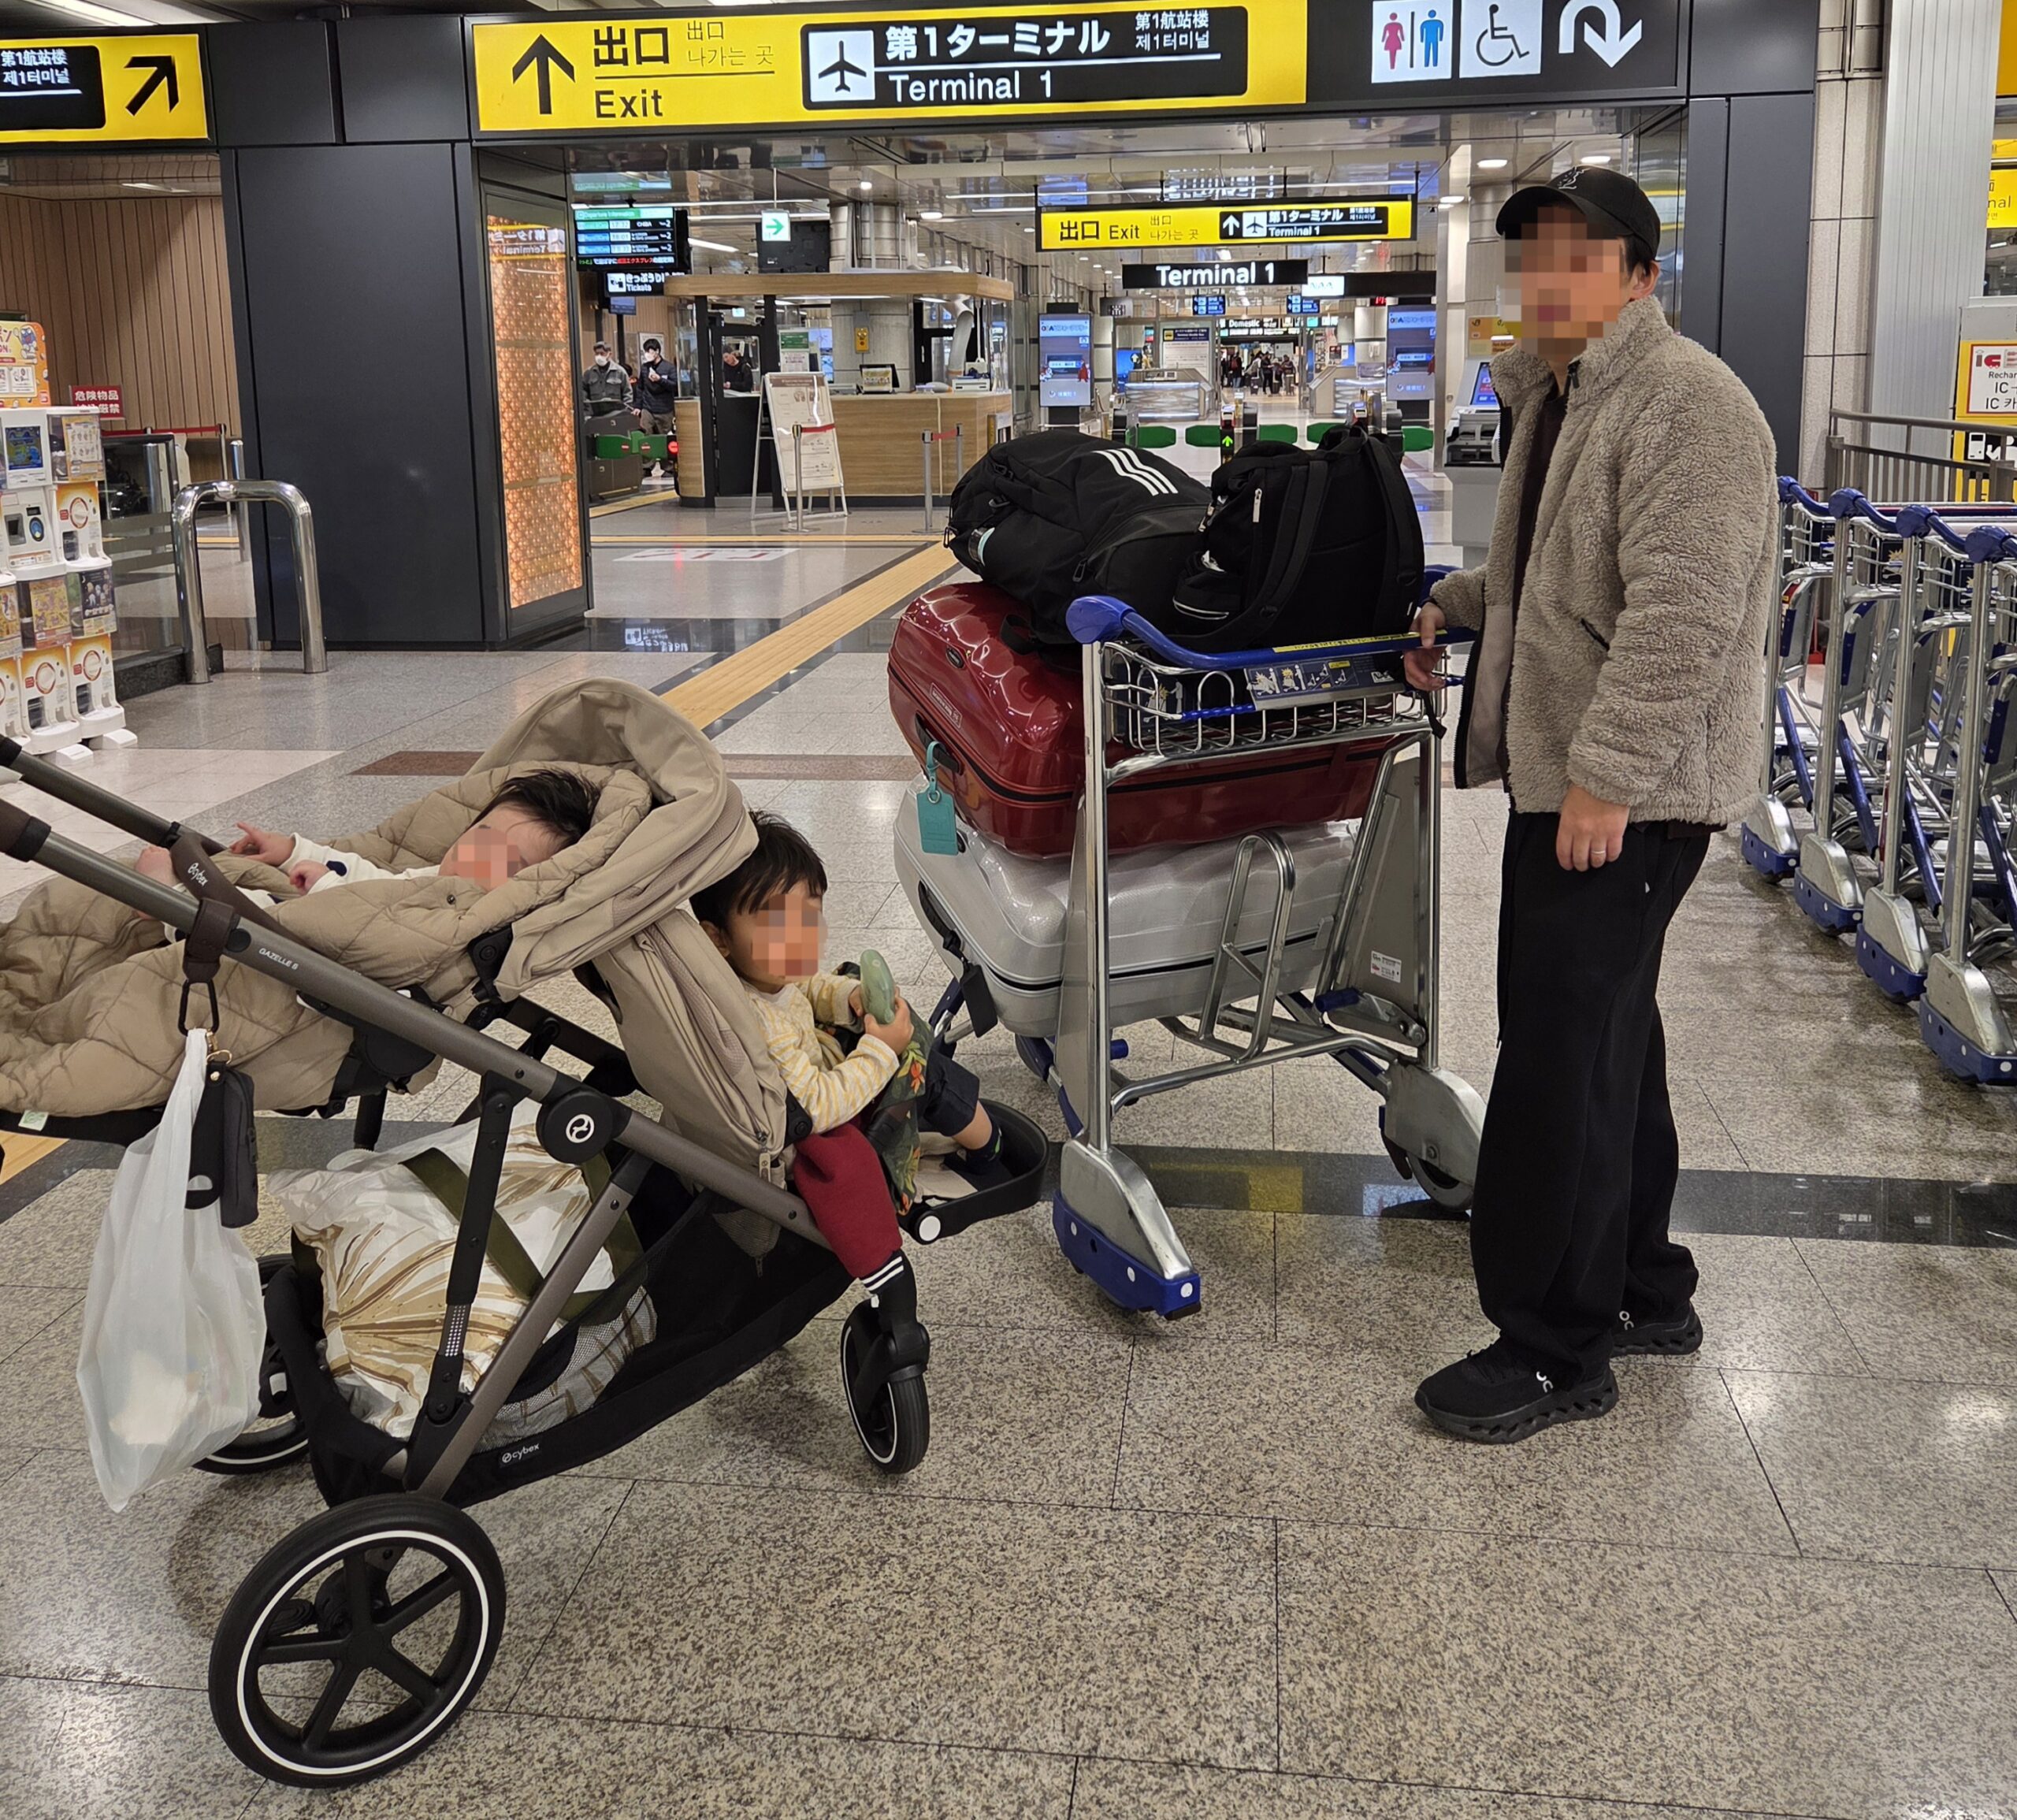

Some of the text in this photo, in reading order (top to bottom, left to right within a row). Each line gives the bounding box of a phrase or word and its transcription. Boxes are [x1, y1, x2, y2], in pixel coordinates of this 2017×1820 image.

[1135, 9, 1209, 31] 第1航站楼
[687, 20, 724, 41] 出口
[593, 25, 670, 67] 出口
[885, 20, 1110, 61] 第1ターミナル
[1135, 31, 1210, 51] 제1터미널
[1, 49, 69, 67] 第1航站楼
[688, 45, 774, 68] 나가는 곳
[3, 68, 70, 86] 제1터미널
[889, 70, 1052, 102] Terminal 1
[596, 88, 663, 119] Exit
[1150, 215, 1172, 226] 出口
[1269, 209, 1344, 223] 第1ターミナル
[1060, 221, 1100, 241] 出口
[1109, 225, 1140, 240] Exit
[1150, 228, 1199, 241] 나가는 곳
[1269, 225, 1321, 236] Terminal 1
[1155, 262, 1275, 287] Terminal 1
[1228, 318, 1260, 328] Domestic
[75, 390, 119, 401] 危険物品
[1995, 382, 2009, 393] IC
[1985, 398, 2000, 410] IC
[258, 947, 292, 968] GAZELLE
[512, 1443, 540, 1461] cybex
